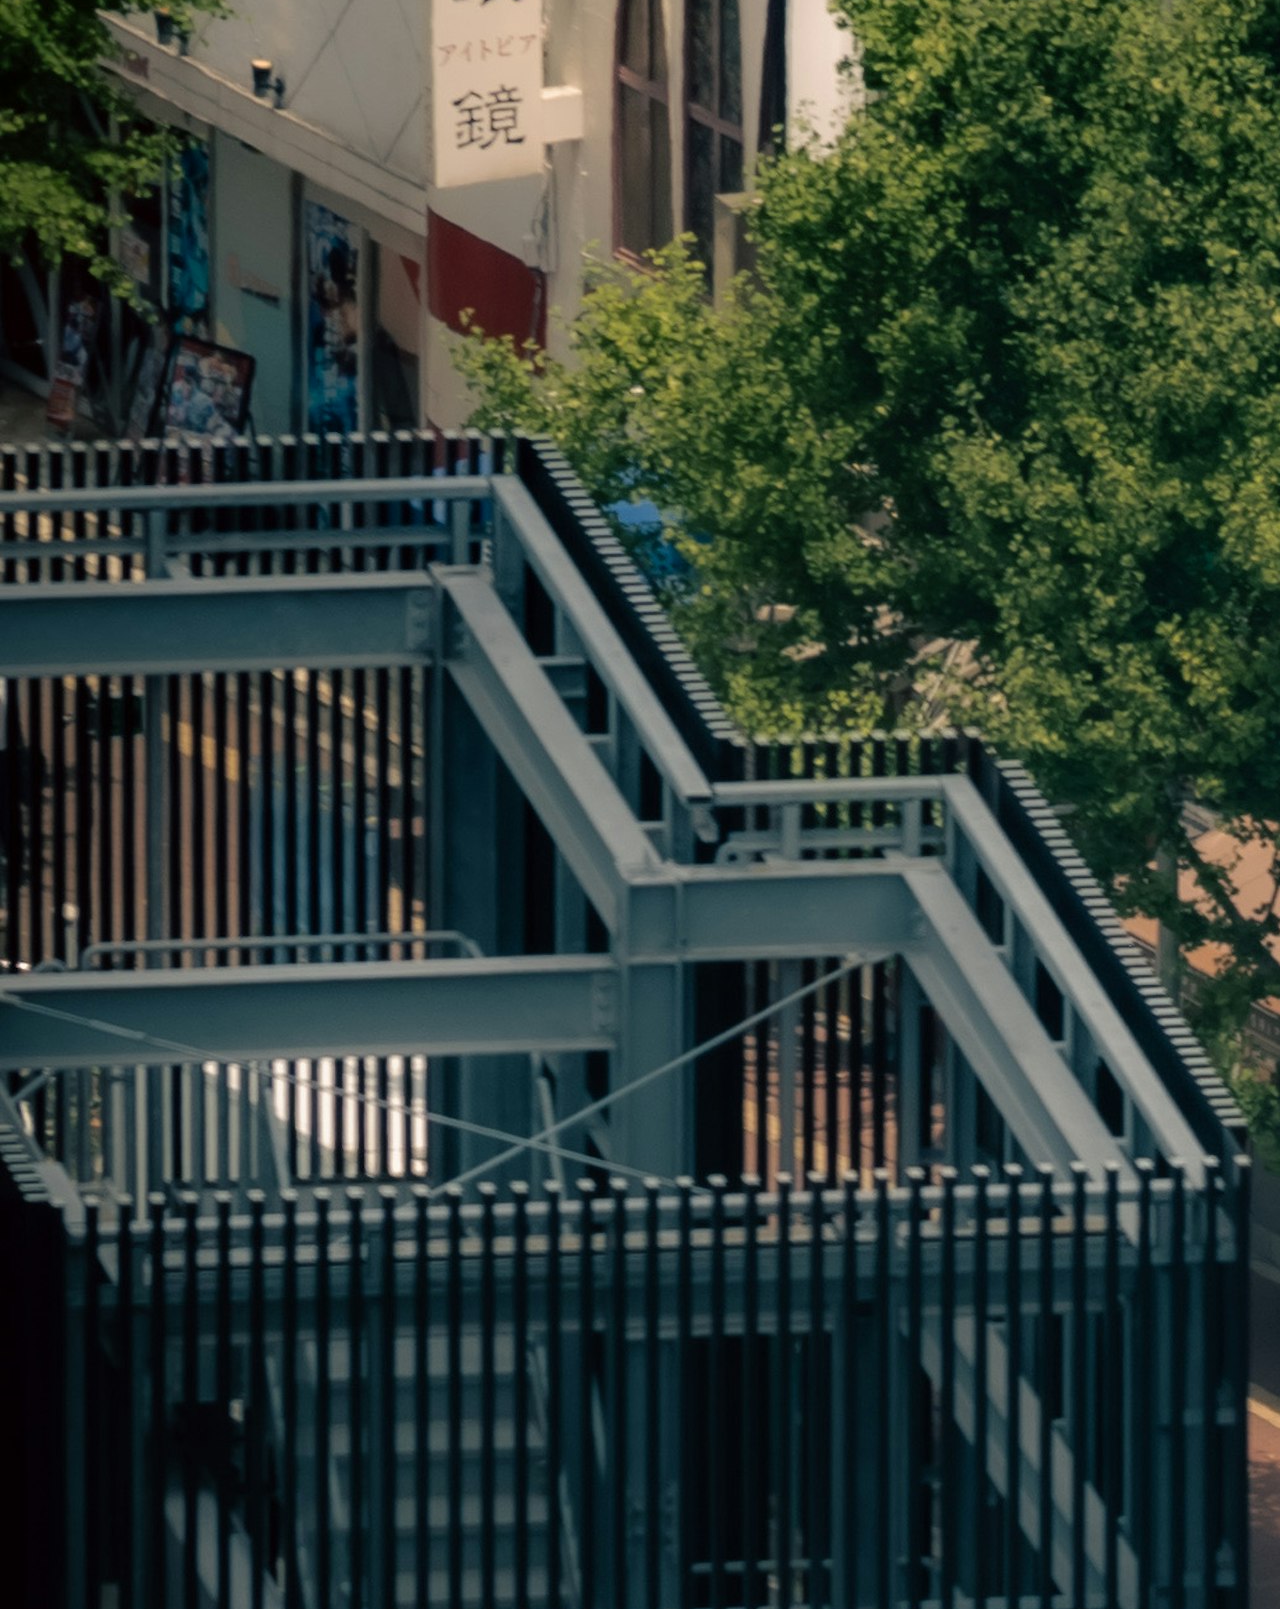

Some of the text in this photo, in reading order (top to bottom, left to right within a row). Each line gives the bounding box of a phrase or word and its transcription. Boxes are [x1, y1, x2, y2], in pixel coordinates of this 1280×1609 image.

[437, 33, 537, 68] アイトピア
[452, 84, 526, 151] 鏡
